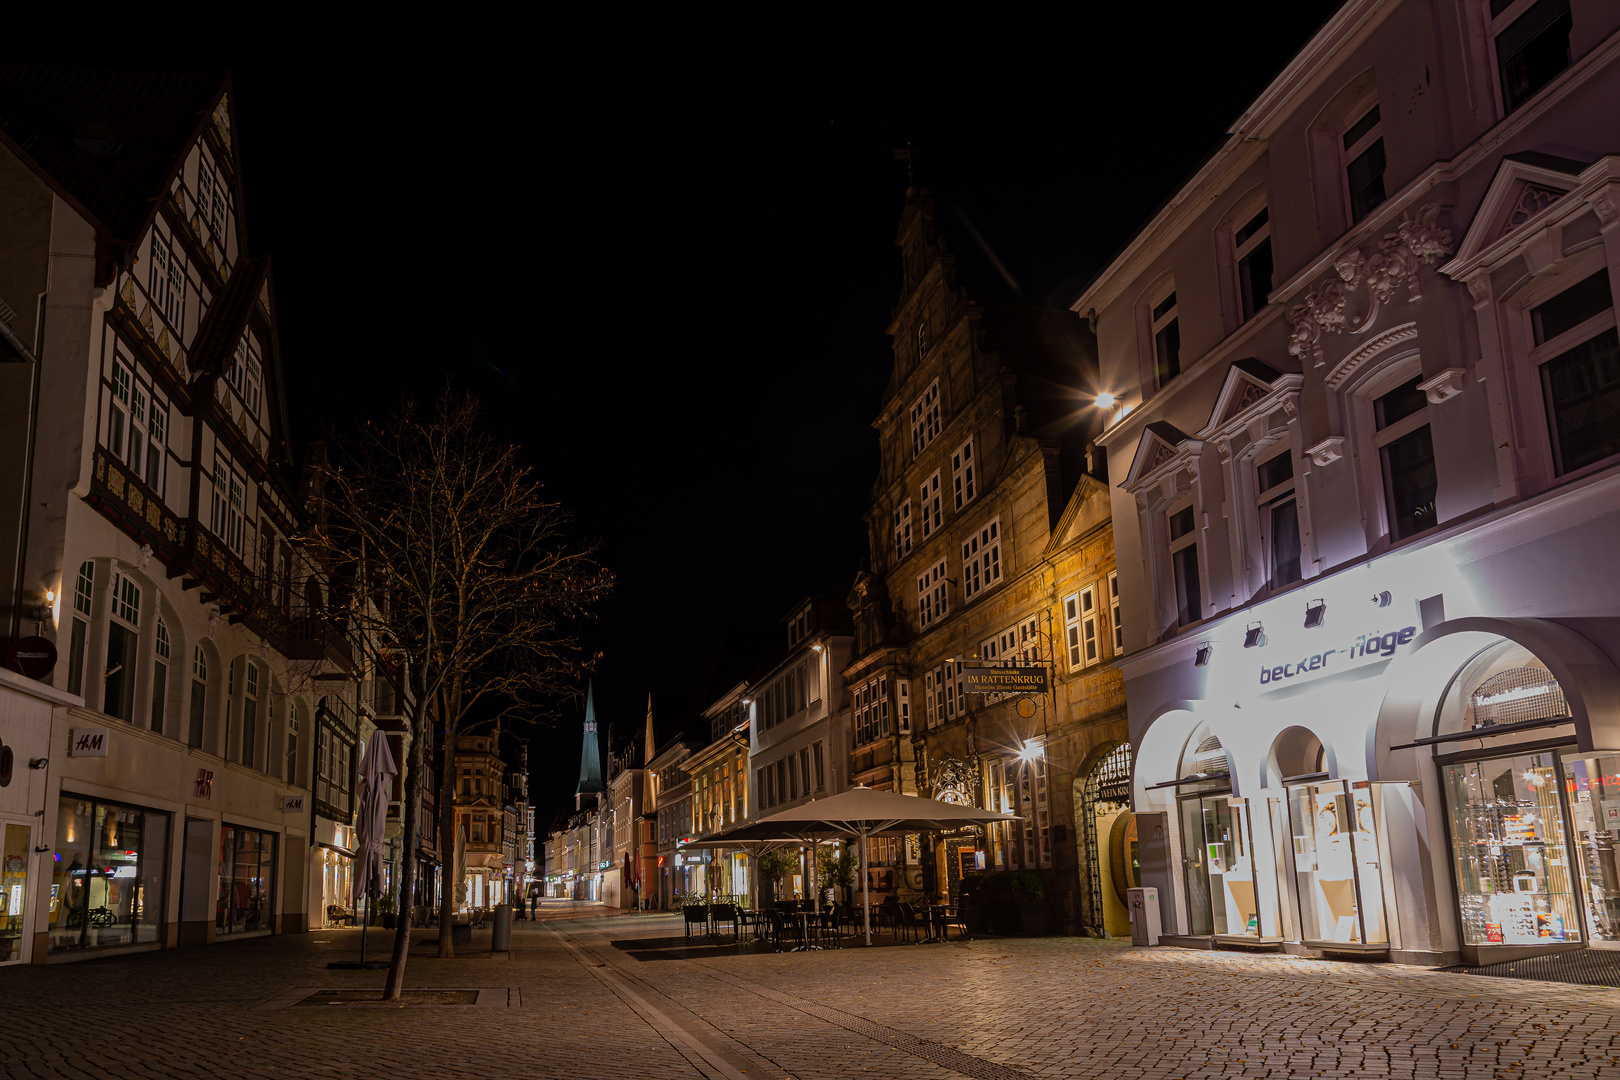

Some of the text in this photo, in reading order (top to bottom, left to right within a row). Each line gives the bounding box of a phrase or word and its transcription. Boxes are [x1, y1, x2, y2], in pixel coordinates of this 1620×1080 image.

[967, 675, 1044, 684] IM RATTENKRUG
[75, 734, 104, 751] H&M
[1101, 787, 1117, 799] WEIN
[285, 799, 302, 810] H&M
